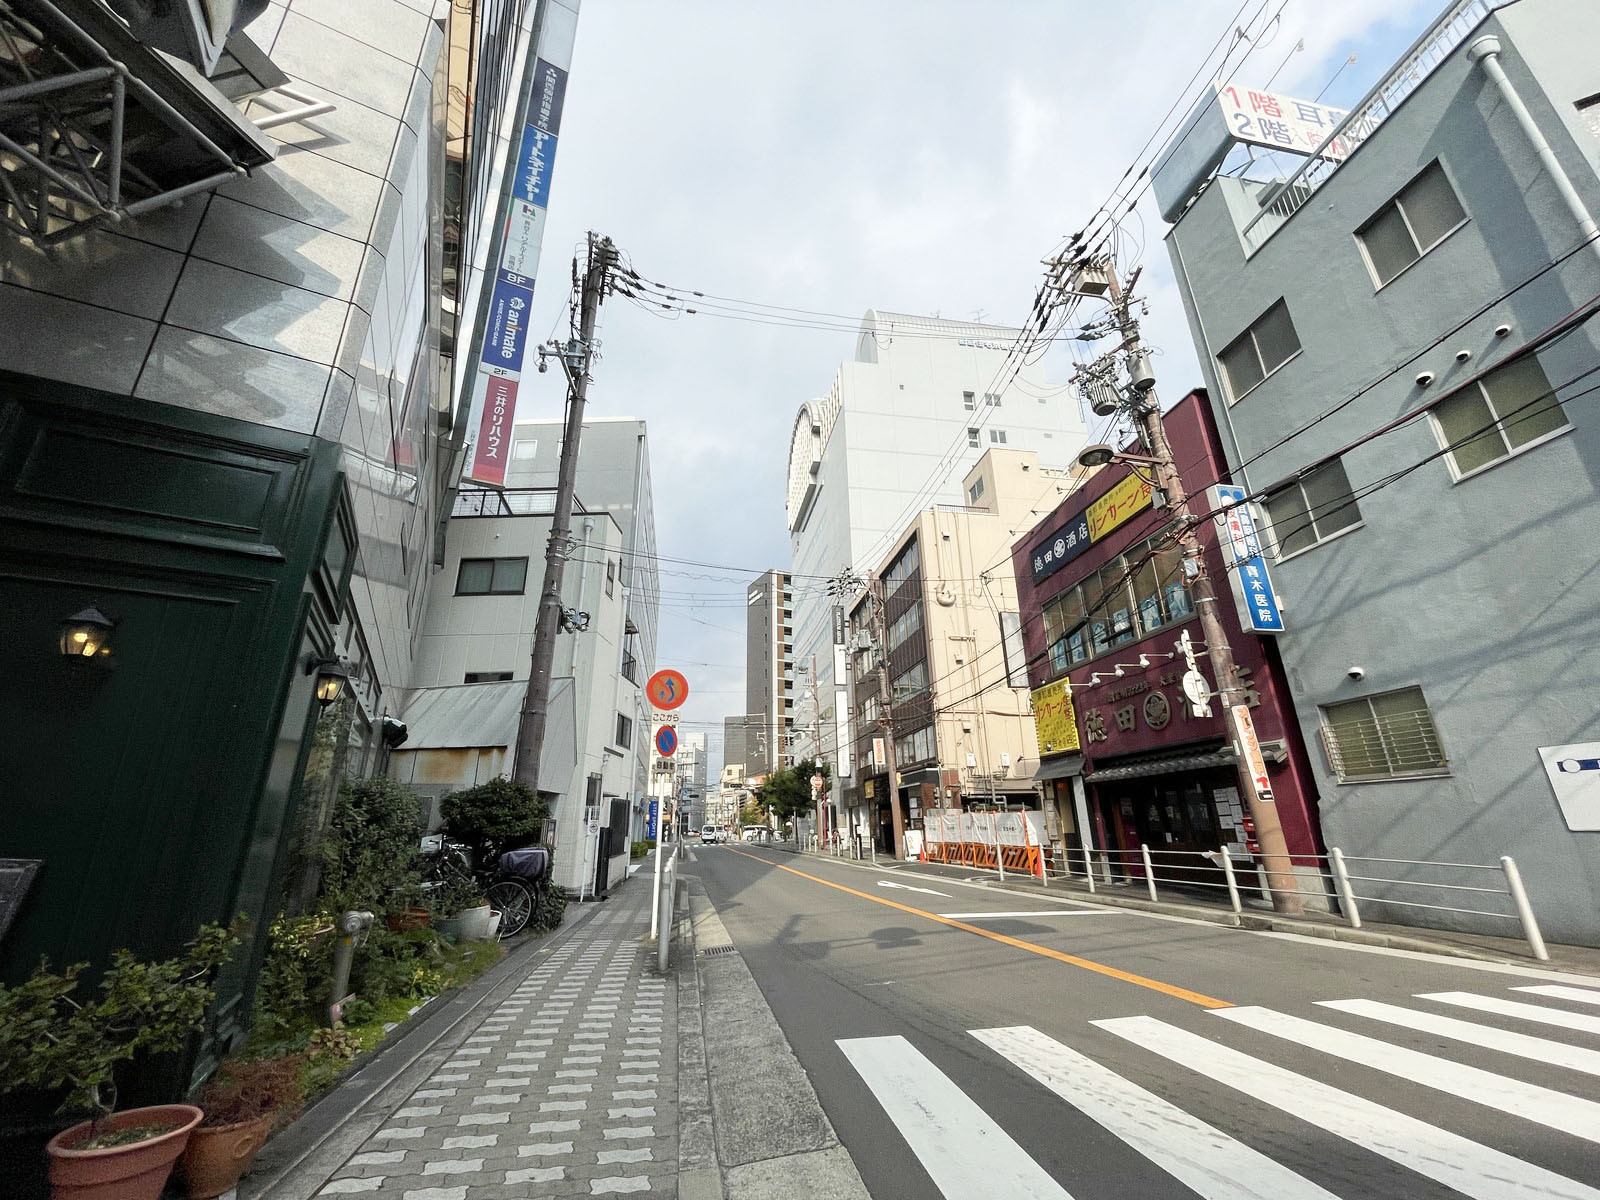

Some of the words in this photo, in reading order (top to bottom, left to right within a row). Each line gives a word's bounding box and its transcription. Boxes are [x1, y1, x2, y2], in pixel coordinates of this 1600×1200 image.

[1225, 86, 1281, 118] 1階
[1234, 113, 1292, 145] 2階
[501, 309, 522, 359] animate
[493, 367, 508, 376] 2F
[485, 385, 508, 459] 三井のリハウス
[1245, 565, 1273, 622] 青木医院
[652, 713, 680, 722] ここから
